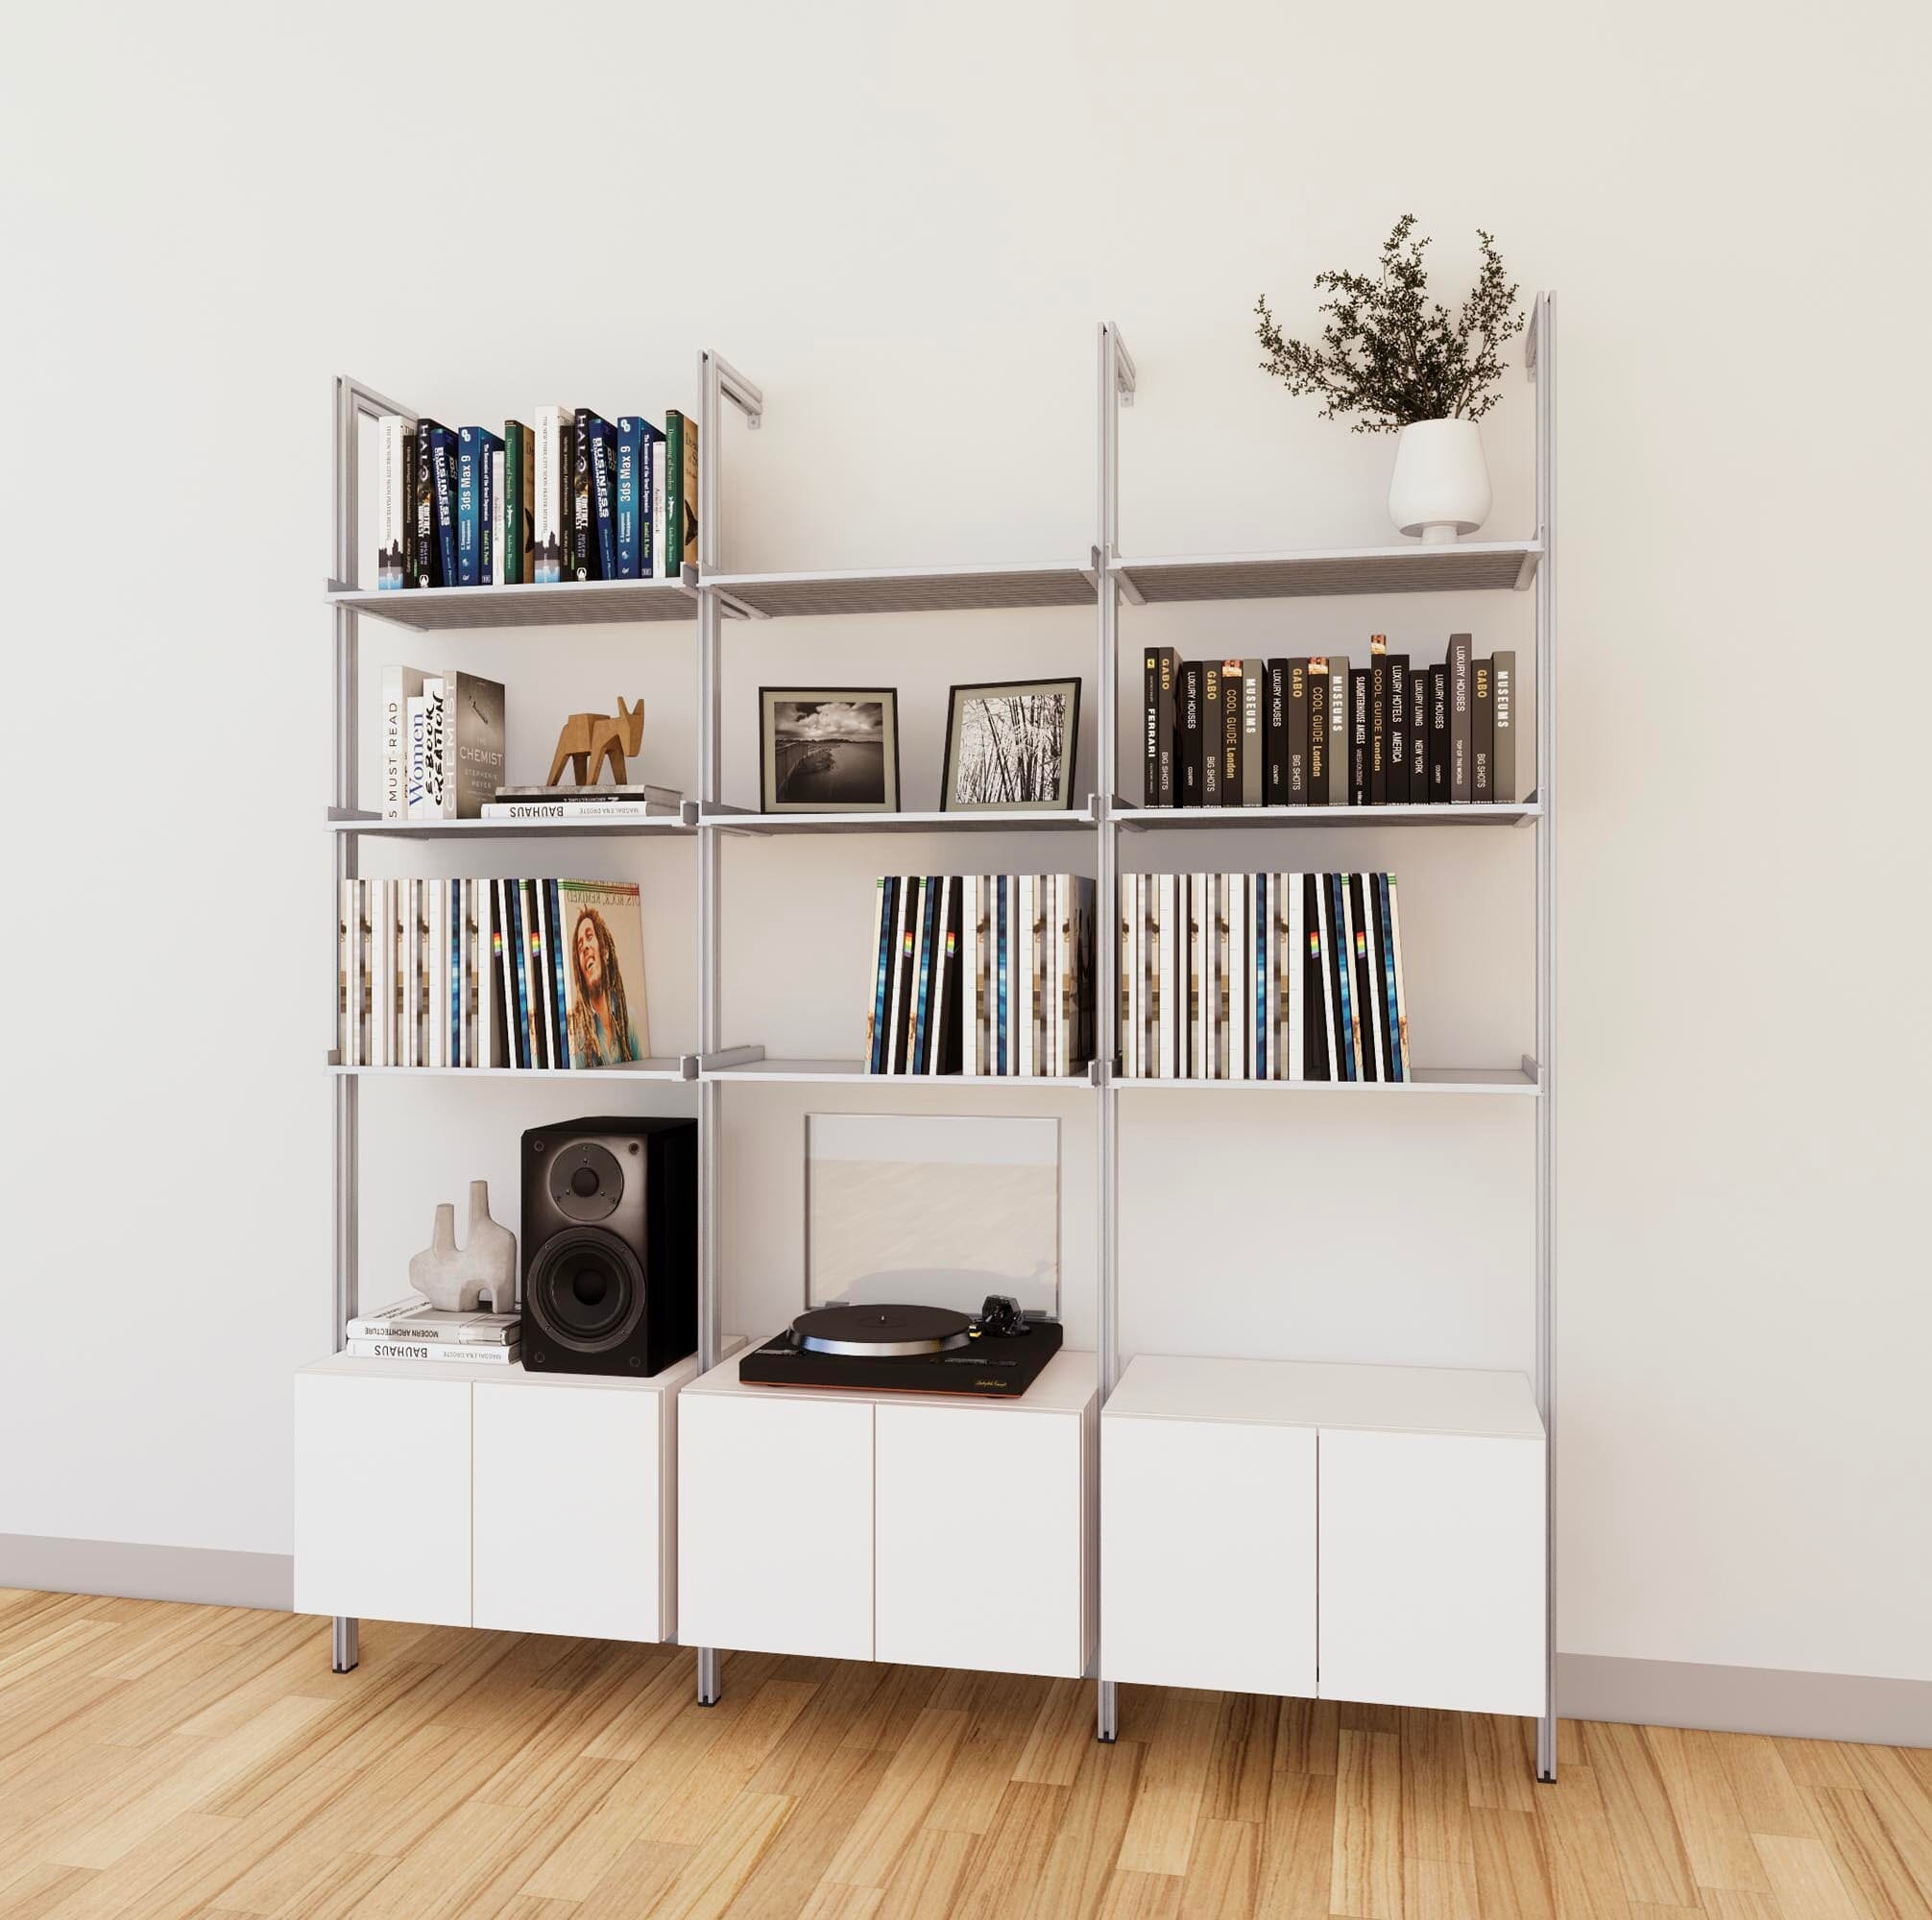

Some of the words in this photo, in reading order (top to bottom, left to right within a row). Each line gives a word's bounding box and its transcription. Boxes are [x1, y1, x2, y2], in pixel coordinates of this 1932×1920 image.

[419, 424, 429, 482] HALO
[576, 415, 587, 472] HALO
[461, 465, 471, 488] Max
[596, 437, 609, 518] BUSINESS
[620, 455, 631, 478] Max
[437, 446, 449, 526] BUSINESS
[620, 482, 631, 502] 3ds
[461, 492, 471, 511] 3ds
[1457, 646, 1465, 677] LUXURY
[1207, 670, 1217, 700] GABO
[1273, 669, 1282, 697] LUXURY
[1292, 668, 1302, 698] GABO
[1392, 665, 1402, 694] LUXURY
[1414, 679, 1423, 705] LUXURY
[1436, 674, 1444, 701] LUXURY
[1477, 669, 1487, 698] GABO
[1226, 689, 1237, 714] COOL
[1246, 678, 1256, 733] MUSEUMS
[1313, 686, 1323, 713] COOL
[1333, 676, 1342, 732] MUSEUMS
[1356, 676, 1365, 723] SLAUGHTERHOUSE
[1392, 694, 1402, 723] HOTELS
[1457, 678, 1465, 712] HOUSES
[1498, 671, 1509, 728] MUSEUMS
[1273, 697, 1282, 727] HOUSES
[1414, 706, 1423, 727] LIVING
[1436, 702, 1444, 729] HOUSES
[1147, 708, 1156, 757] FERRARI
[1226, 717, 1237, 744] GUIDE
[1313, 716, 1323, 743] GUIDE
[1356, 725, 1365, 744] ANGELS
[409, 713, 423, 806] Women
[425, 704, 434, 794] E-BOOK
[433, 691, 445, 805] CREATION
[446, 684, 455, 812] CHEMIST
[459, 746, 503, 766] CHEMIST
[1392, 732, 1402, 763] AMERICA
[1414, 739, 1423, 755] NEW
[1477, 754, 1485, 765] BIG
[1207, 756, 1216, 769] BIG
[1226, 748, 1237, 779] London
[1292, 755, 1301, 767] BIG
[1313, 746, 1323, 778] London
[1414, 756, 1423, 774] YORK
[1207, 769, 1216, 792] SHOTS
[1292, 768, 1301, 791] SHOTS
[1477, 766, 1485, 788] SHOTS
[509, 806, 564, 818] BAUHAUS
[365, 1327, 412, 1337] ARCHITECTURE
[412, 1329, 439, 1338] MODERN
[374, 1345, 428, 1358] BAUHAUS
